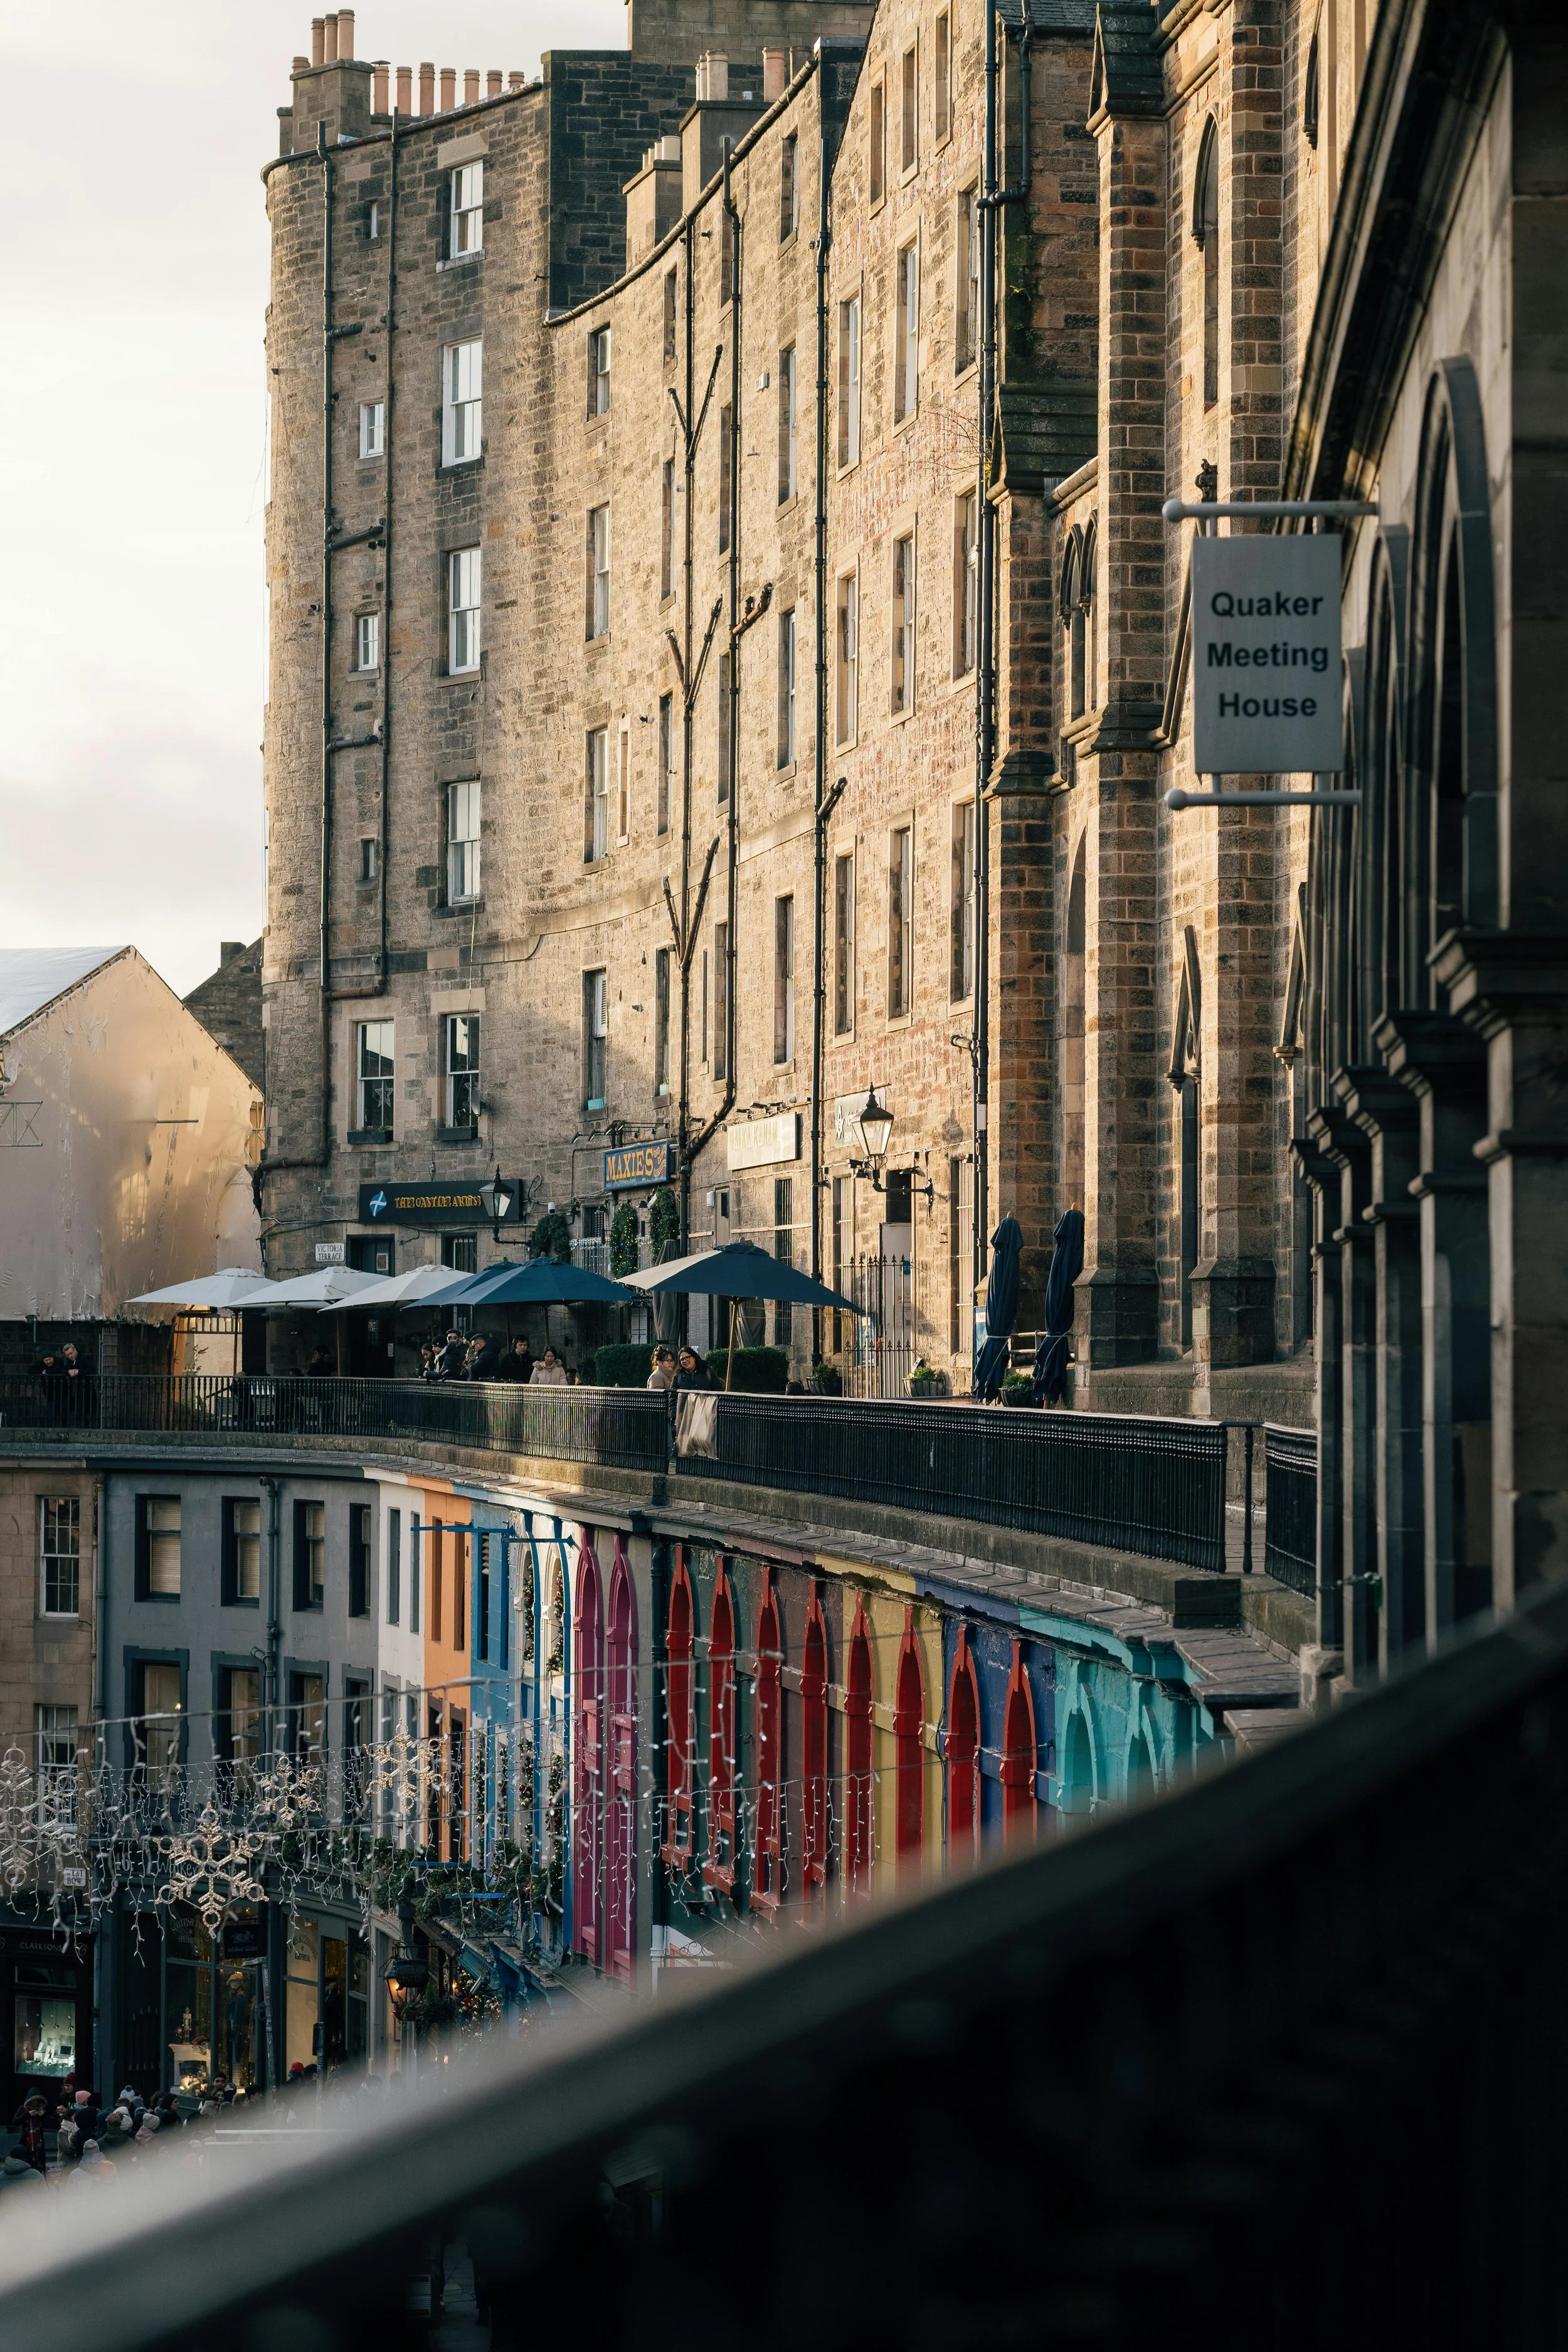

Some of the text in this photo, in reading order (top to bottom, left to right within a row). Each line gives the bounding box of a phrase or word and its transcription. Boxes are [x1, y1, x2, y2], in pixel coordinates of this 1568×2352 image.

[1210, 591, 1323, 617] Quaker
[1207, 642, 1328, 673] Meeting
[1219, 692, 1317, 718] House
[606, 1147, 654, 1182] MAXIES
[395, 1195, 481, 1209] THE CASTLE ARMS
[317, 1244, 343, 1253] VICTORIA
[318, 1253, 342, 1261] TERRACE
[67, 1877, 82, 1885] BOW
[307, 1879, 344, 1900] LADIESWEAR
[19, 1942, 63, 1952] CLARKSONS
